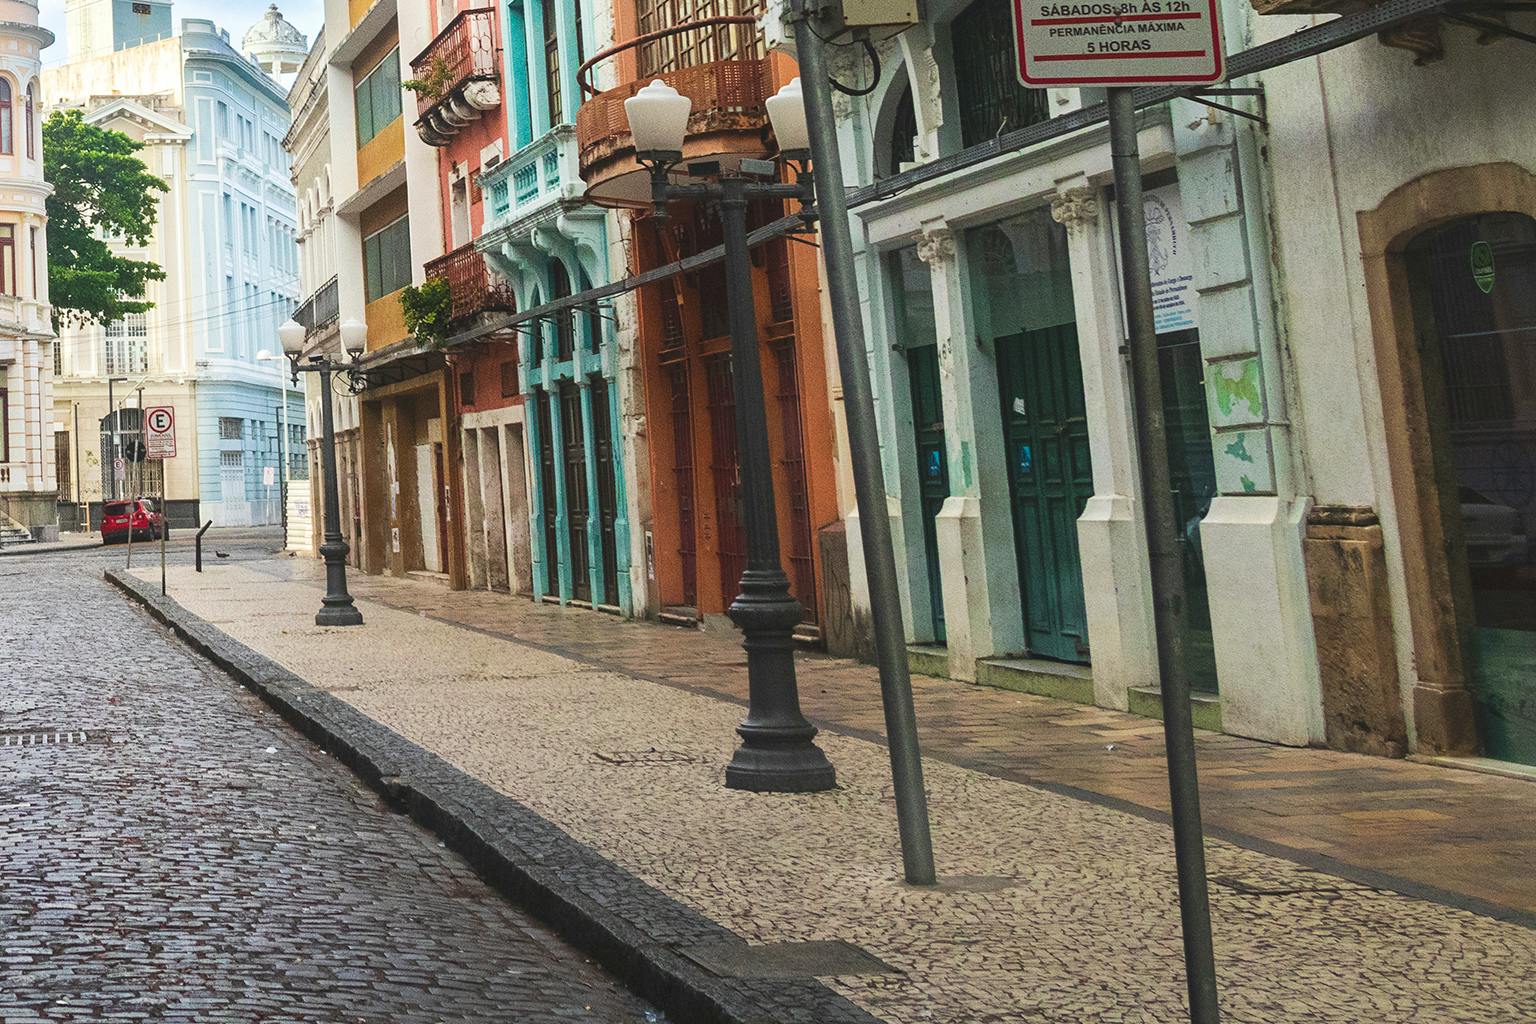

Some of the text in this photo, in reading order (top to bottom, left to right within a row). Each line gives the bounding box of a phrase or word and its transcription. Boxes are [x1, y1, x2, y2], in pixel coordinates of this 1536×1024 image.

[1041, 0, 1190, 16] SÁBADOS: 8h ÀS 12h
[1049, 22, 1185, 37] PERMANÊNCIA MÁXIMA
[1088, 40, 1151, 52] 5 HORAS
[156, 414, 165, 428] E
